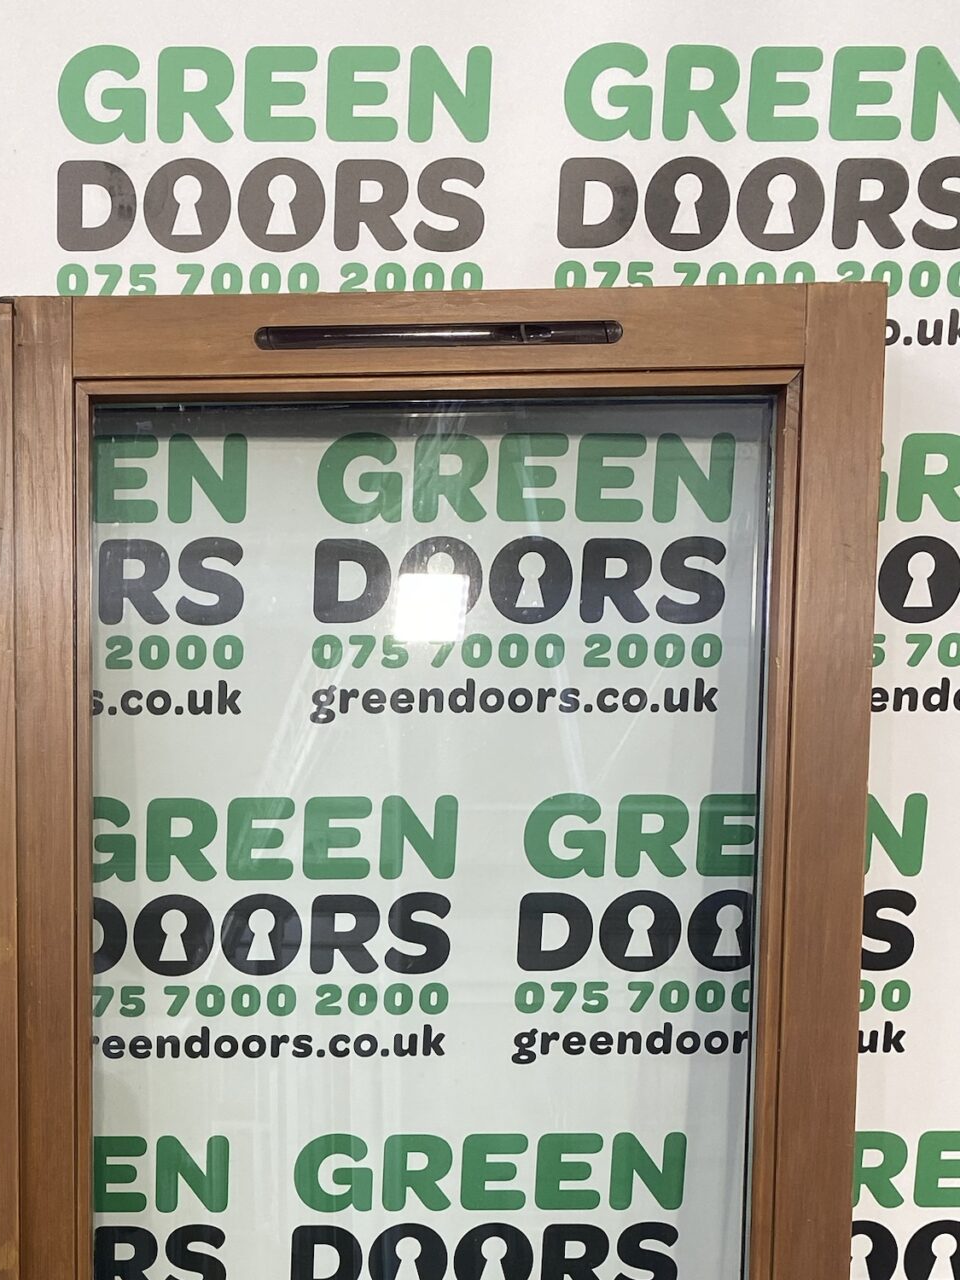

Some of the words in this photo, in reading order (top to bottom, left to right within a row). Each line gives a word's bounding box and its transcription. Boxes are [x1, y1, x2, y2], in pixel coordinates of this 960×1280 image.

[58, 45, 492, 144] GREEN
[57, 157, 485, 253] DOORS
[57, 264, 156, 296] 075
[177, 262, 319, 294] 7000
[341, 262, 483, 291] 2000
[317, 433, 736, 525] GREEN
[106, 634, 244, 670] 2000
[312, 634, 409, 669] 075
[432, 633, 565, 669] 7000
[583, 633, 724, 669] 2000
[310, 679, 718, 724] greendoors.co.uk
[163, 984, 297, 1017] 7000
[315, 982, 449, 1016] 2000
[514, 981, 609, 1014] 075
[93, 1027, 445, 1059] eendoors.co.uk
[293, 1129, 688, 1213] GREEN
